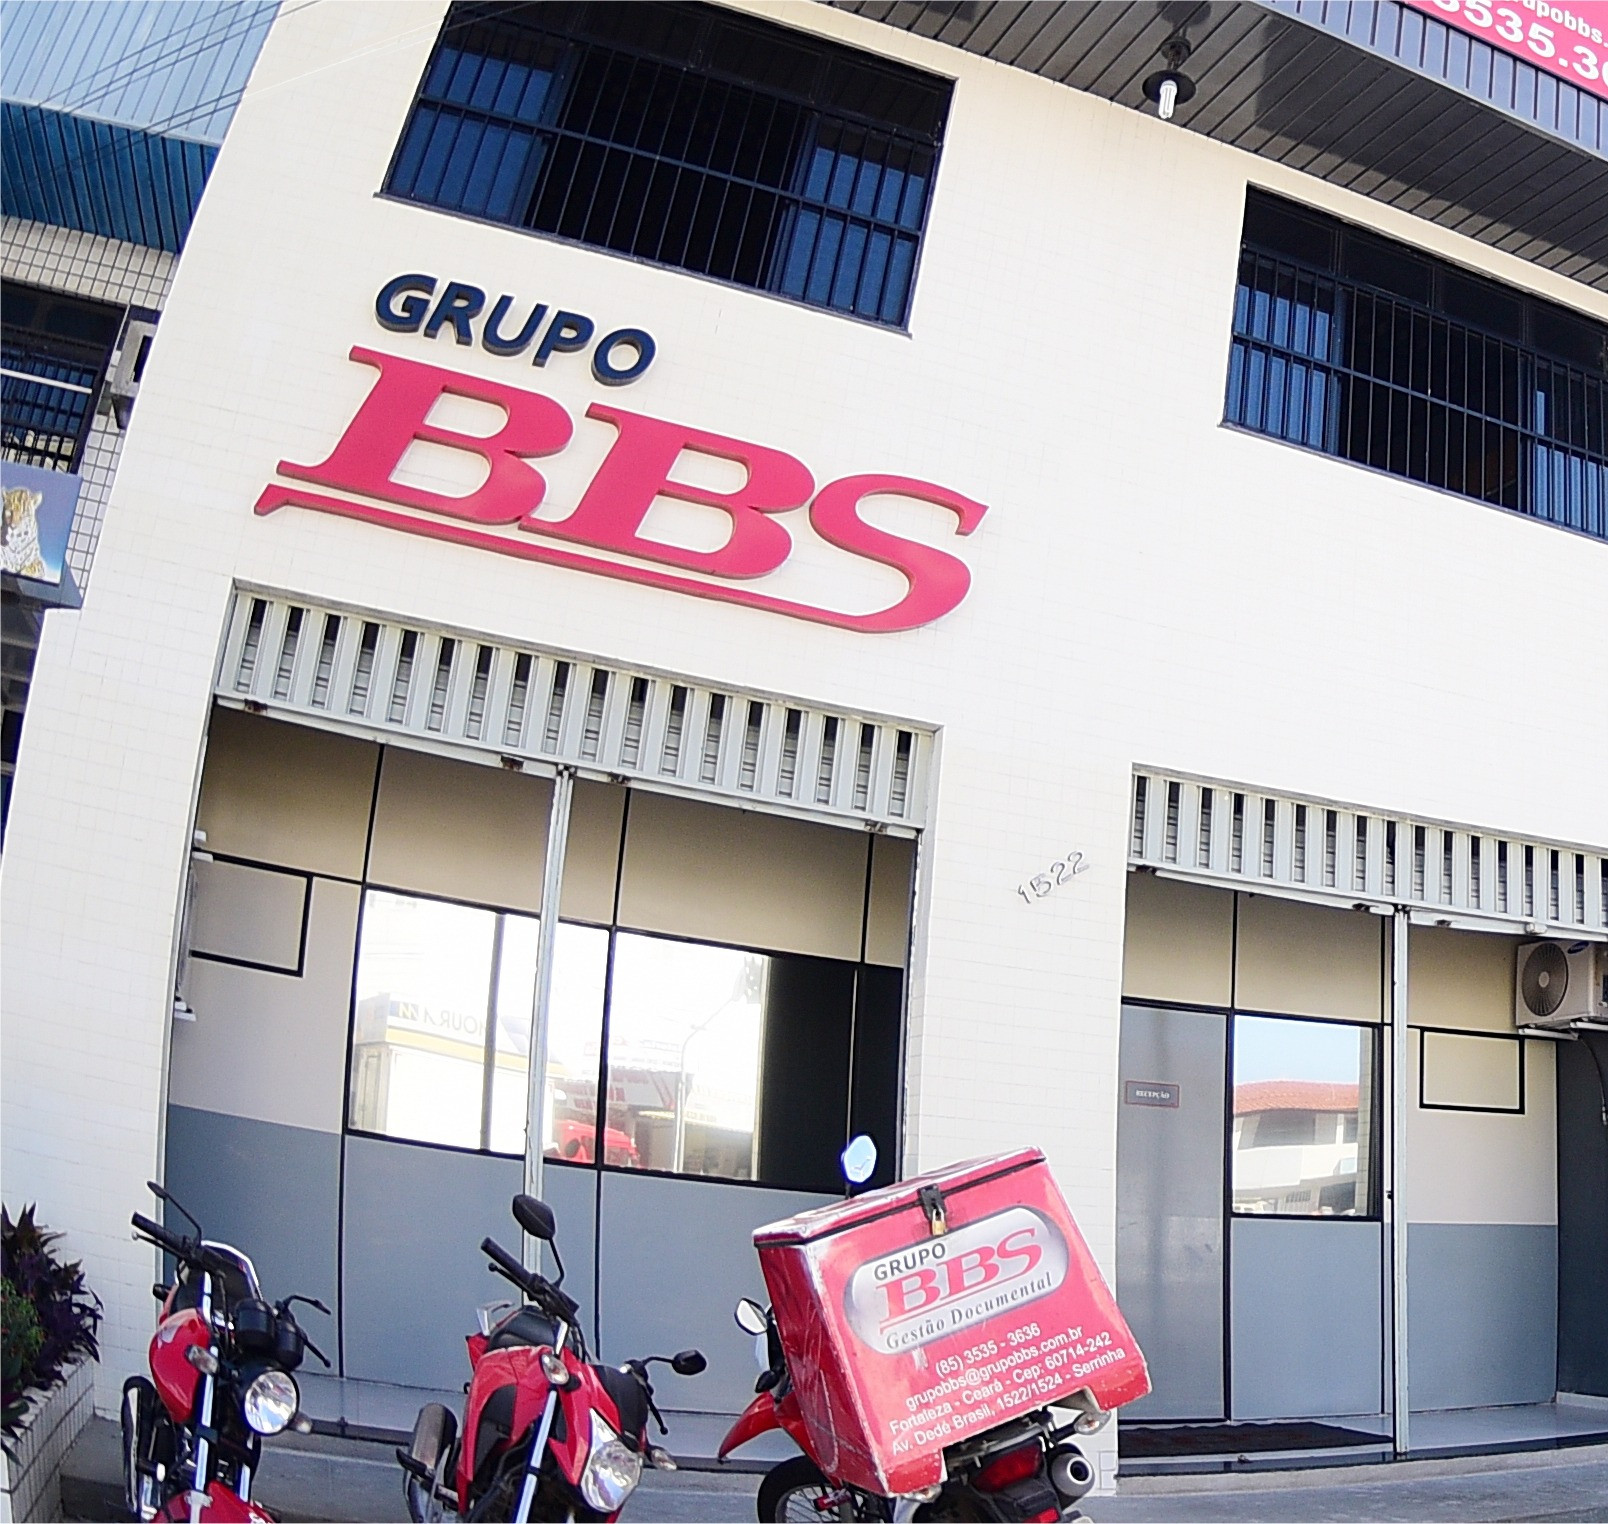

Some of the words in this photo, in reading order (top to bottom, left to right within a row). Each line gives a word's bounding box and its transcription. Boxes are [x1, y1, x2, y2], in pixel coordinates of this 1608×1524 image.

[374, 272, 658, 386] GRUPO
[255, 345, 990, 633] BBS
[1017, 850, 1090, 904] 1522
[874, 1242, 947, 1281] GRUPO
[876, 1227, 1043, 1332] BBS
[886, 1315, 945, 1349] Gestão
[950, 1271, 1052, 1326] Documental
[935, 1355, 964, 1378] (85)
[964, 1340, 996, 1366] 3535
[1006, 1322, 1042, 1347] 3636
[889, 1403, 952, 1435] Fortaleza
[962, 1378, 1004, 1407] Ceará
[1012, 1362, 1046, 1386] Cep:
[1044, 1331, 1113, 1371] 60714-242
[891, 1437, 914, 1455] Av.
[914, 1418, 952, 1446] Dedé
[954, 1404, 997, 1429] Brasil,
[997, 1374, 1064, 1412] 1522/1524
[1071, 1345, 1127, 1378] Serrinha
[905, 1324, 1084, 1412] grupobbs@grupobbs.com.br
